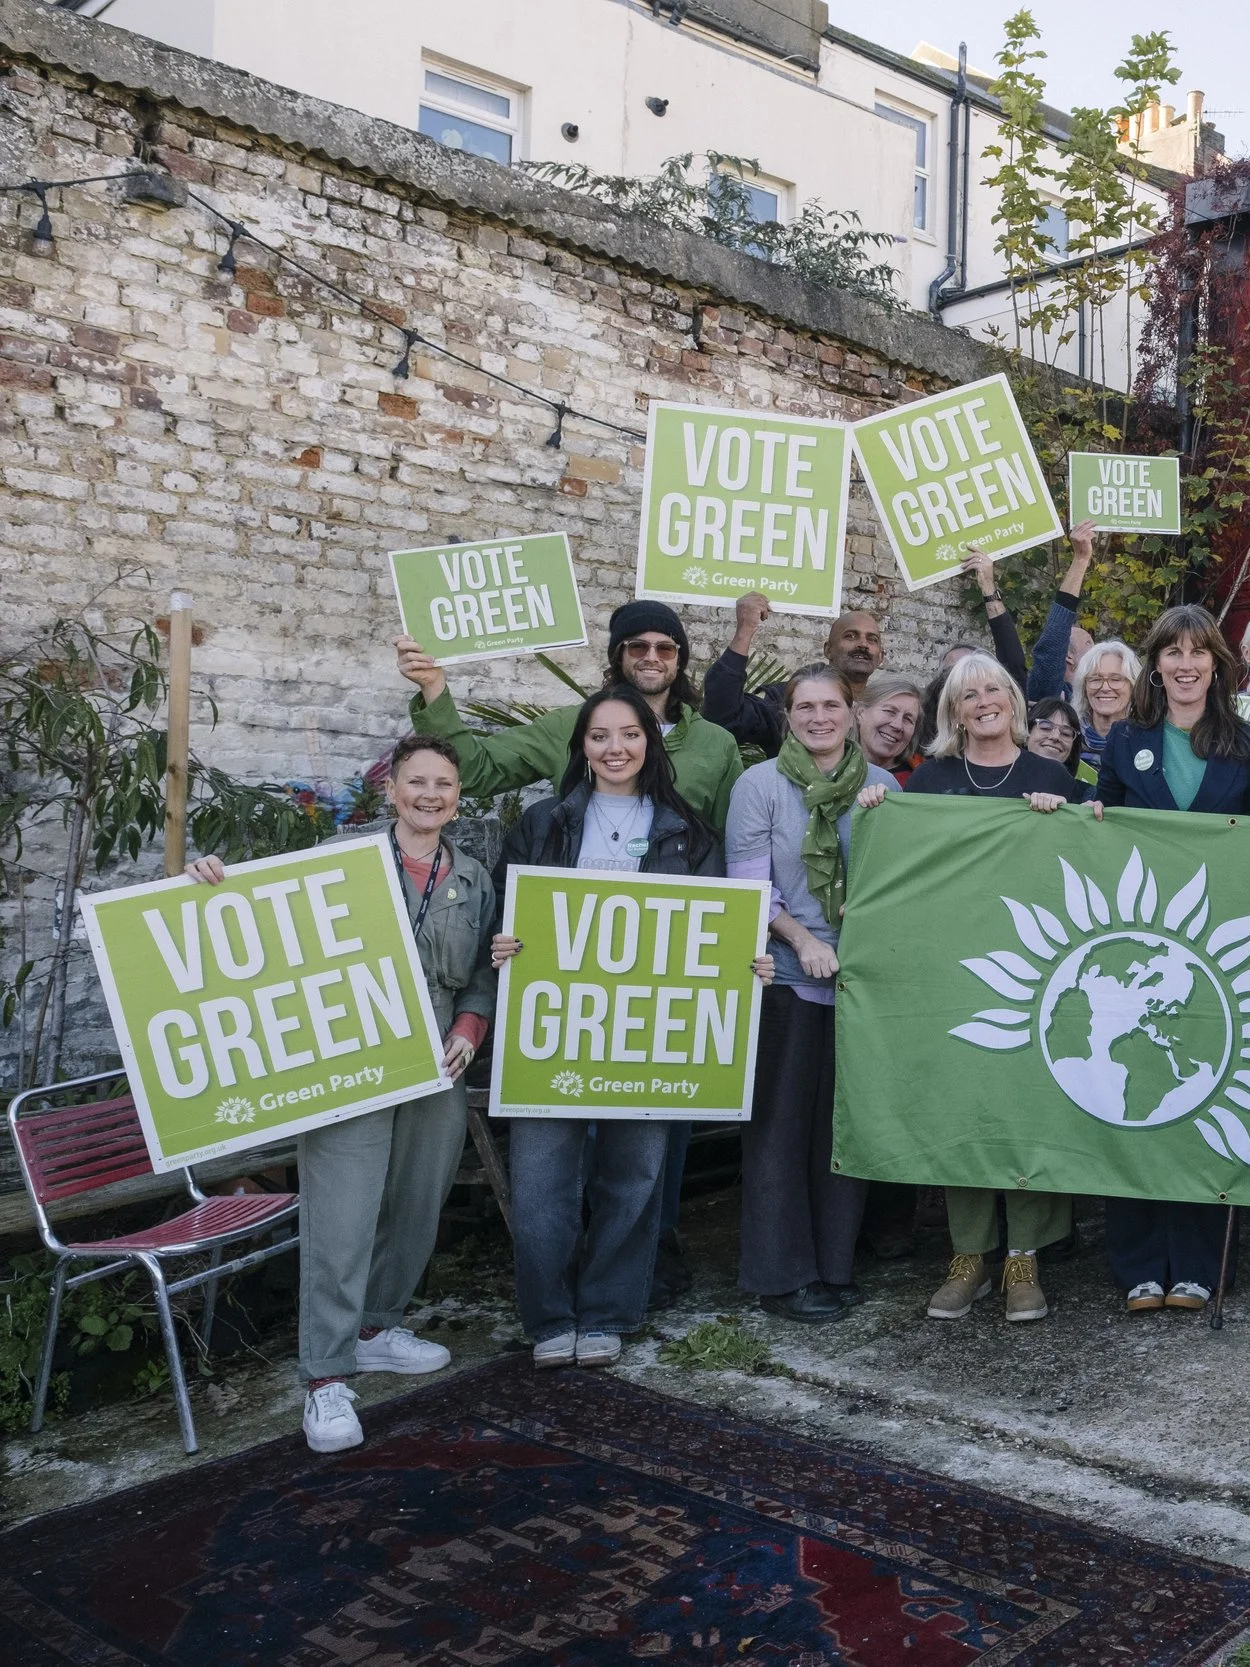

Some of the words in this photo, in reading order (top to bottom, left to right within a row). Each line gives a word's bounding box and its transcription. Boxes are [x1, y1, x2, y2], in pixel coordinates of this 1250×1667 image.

[683, 422, 817, 498] VOTE
[879, 397, 1001, 481] VOTE
[892, 452, 1037, 546] GREEN
[1099, 459, 1151, 487] VOTE
[1087, 486, 1162, 518] GREEN
[658, 492, 829, 571] GREEN
[994, 521, 1025, 540] Party
[438, 545, 528, 592] VOTE
[712, 572, 756, 588] Green
[760, 577, 798, 595] Party
[430, 584, 555, 640] GREEN
[486, 639, 507, 647] Green
[507, 637, 524, 645] Party
[142, 869, 363, 993] VOTE
[552, 892, 725, 977] VOTE
[147, 956, 412, 1098] GREEN
[519, 980, 738, 1065] GREEN
[259, 1084, 325, 1112] Green
[330, 1064, 385, 1092] Party
[589, 1076, 644, 1094] Green
[651, 1078, 700, 1098] Party
[164, 1143, 227, 1169] greenparty.org.uk
